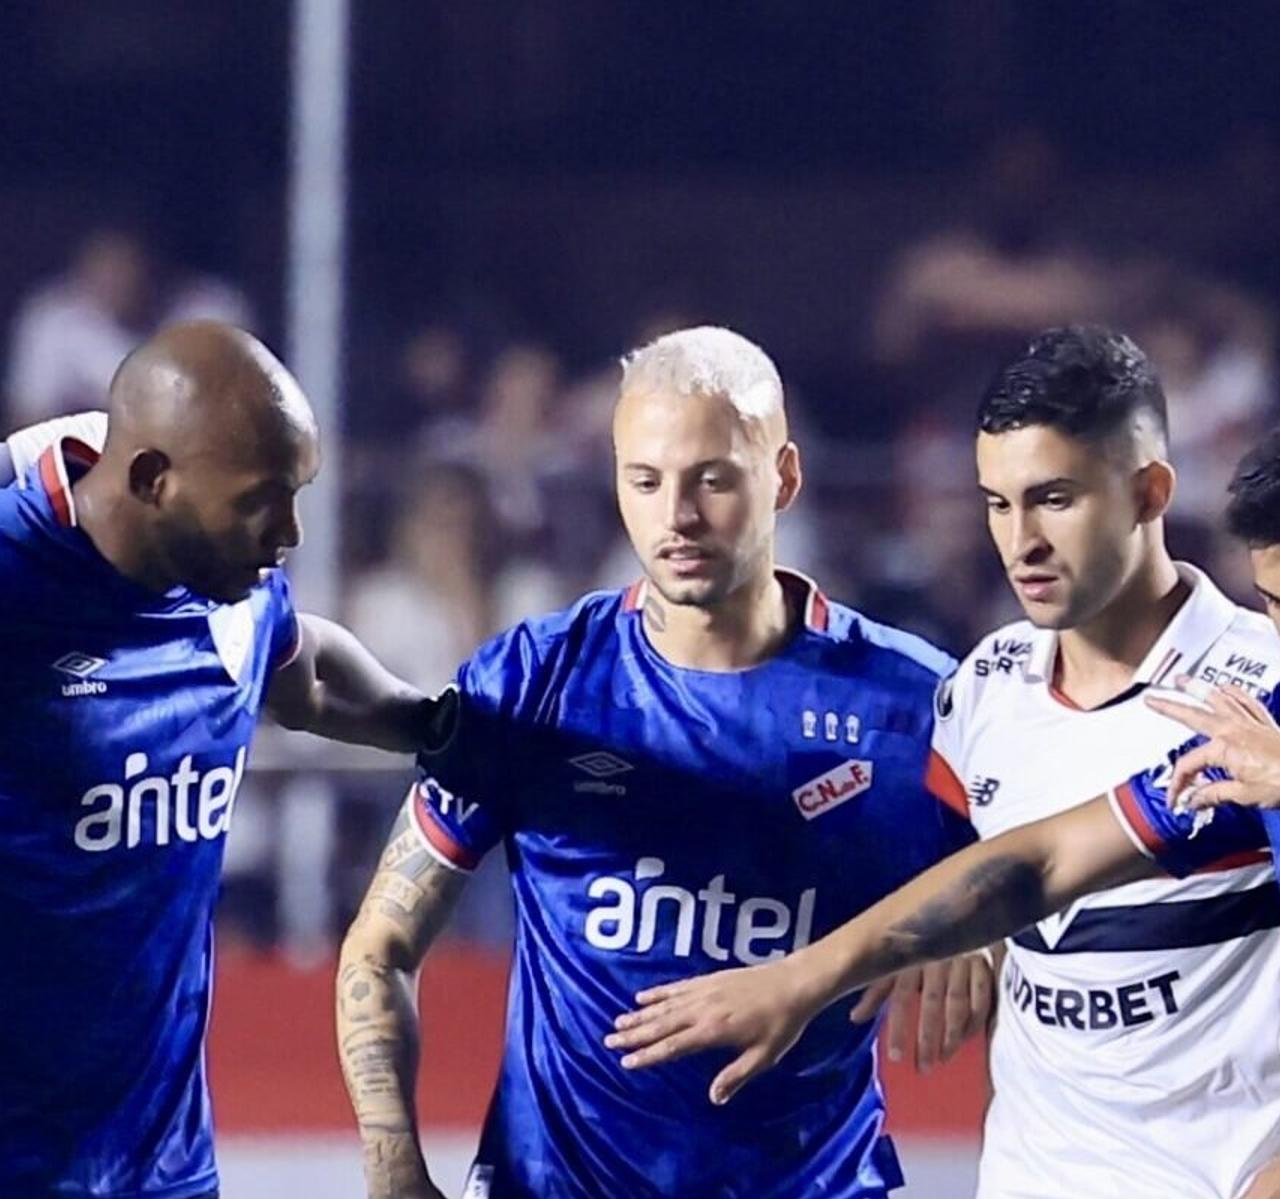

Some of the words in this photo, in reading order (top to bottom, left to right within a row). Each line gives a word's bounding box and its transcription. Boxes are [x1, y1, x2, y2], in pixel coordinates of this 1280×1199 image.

[61, 680, 108, 696] umbro
[1225, 653, 1267, 678] VIVA
[73, 745, 247, 852] antel
[584, 856, 817, 967] antel
